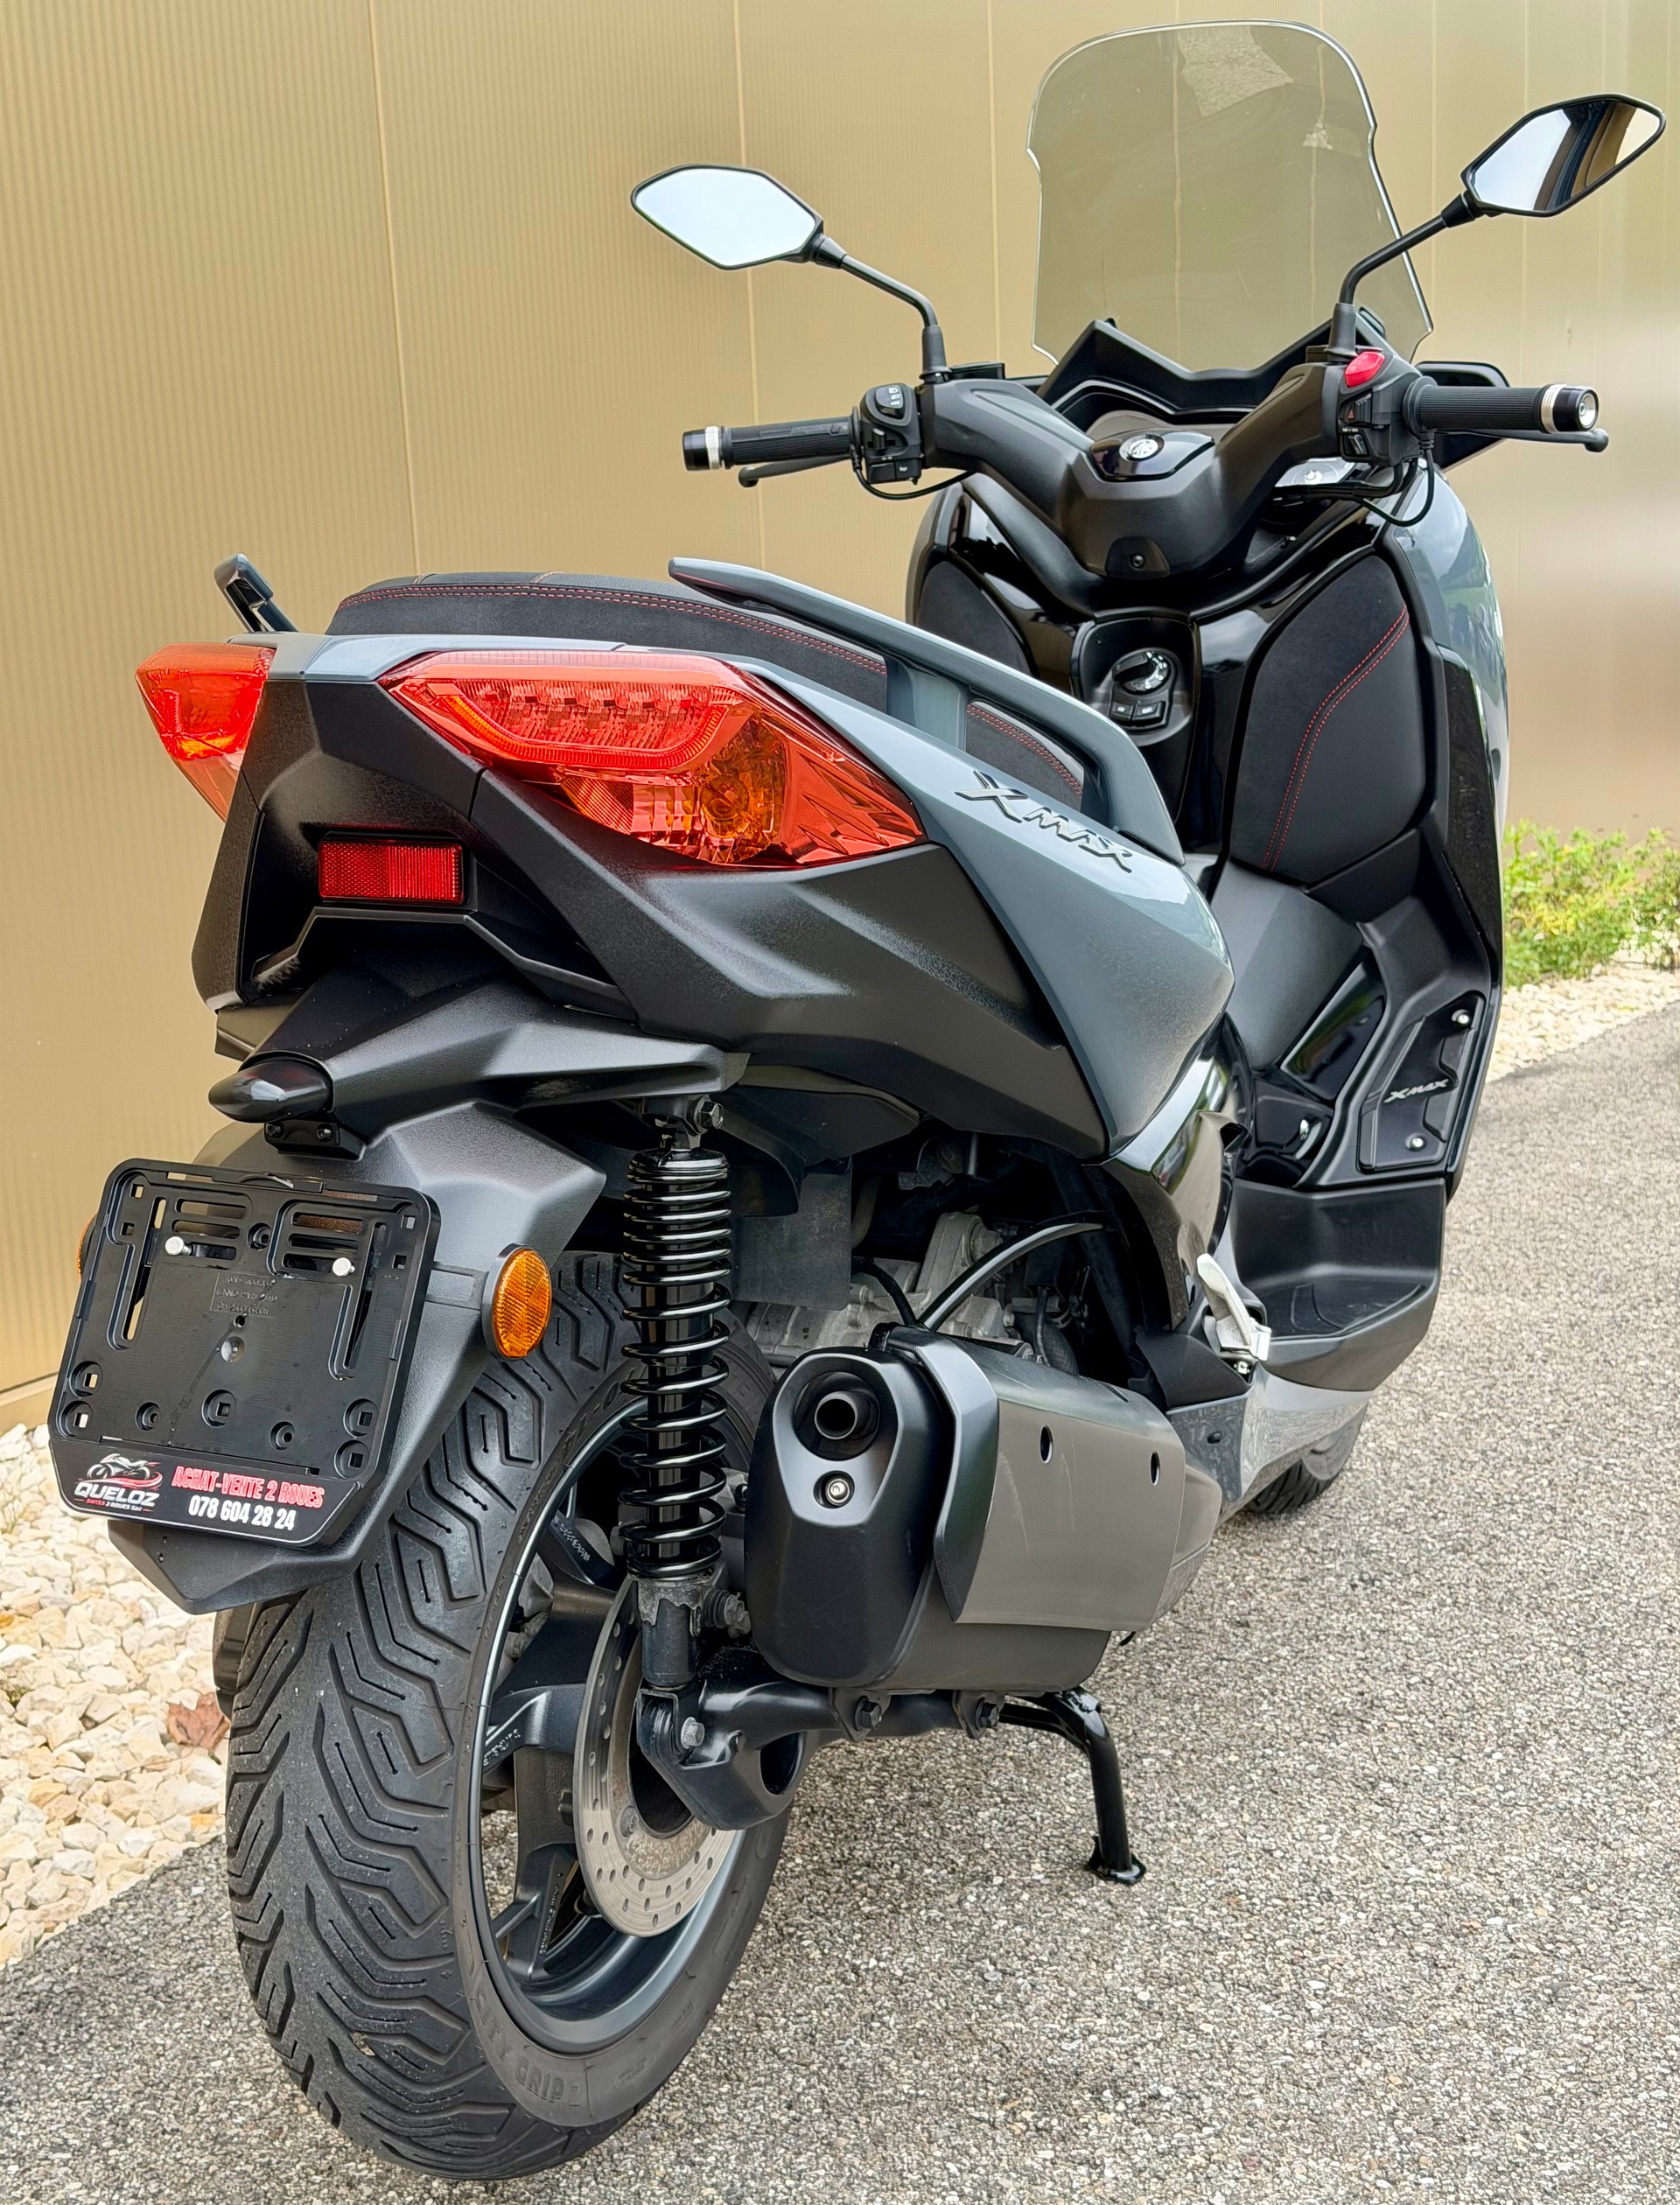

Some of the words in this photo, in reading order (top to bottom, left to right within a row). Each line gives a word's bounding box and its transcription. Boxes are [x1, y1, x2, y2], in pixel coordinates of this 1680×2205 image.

[74, 1482, 160, 1507] QUELOZ
[172, 1466, 265, 1499] ACHAT-VENTE
[264, 1480, 278, 1502] 2
[277, 1481, 326, 1508] ROUES
[188, 1494, 220, 1519] 078
[220, 1500, 251, 1524] 604
[251, 1504, 274, 1527] 28
[274, 1508, 297, 1531] 24
